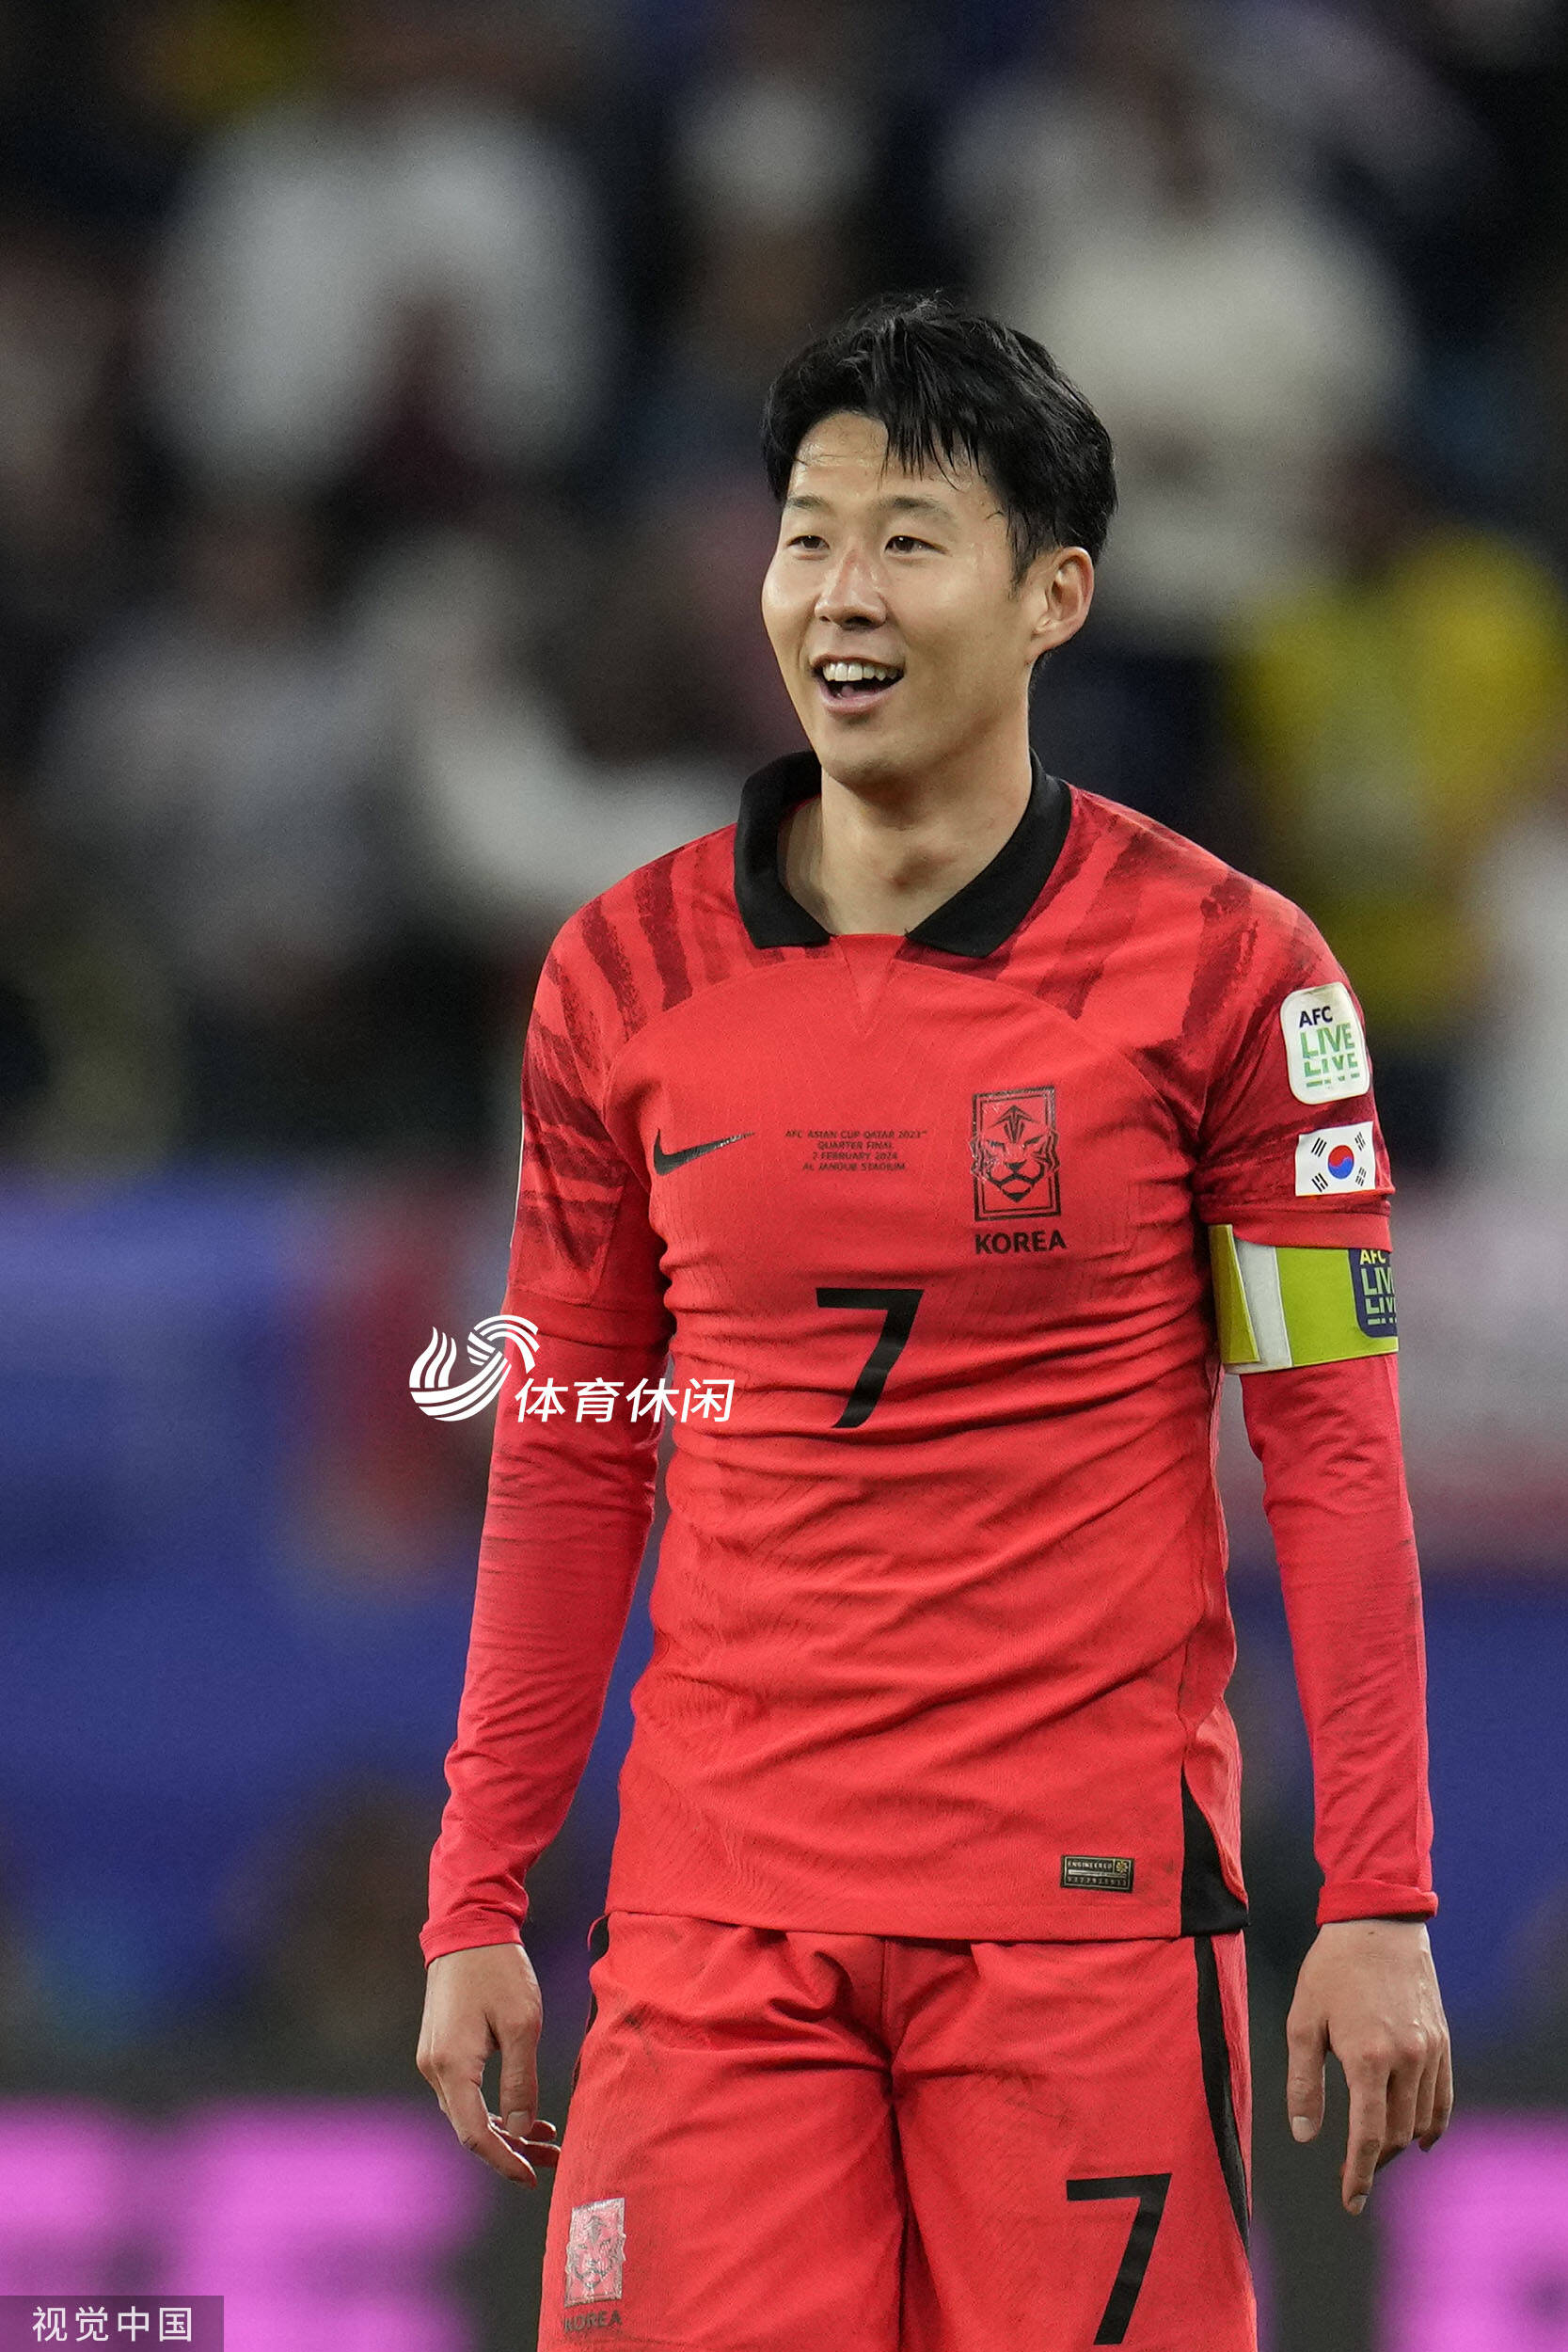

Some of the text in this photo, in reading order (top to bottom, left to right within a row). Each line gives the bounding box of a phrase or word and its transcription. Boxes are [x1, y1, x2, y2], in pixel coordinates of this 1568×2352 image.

[1298, 1006, 1334, 1028] AFC
[1300, 1022, 1355, 1059] LIVE
[785, 1130, 802, 1138] AFC
[807, 1130, 837, 1138] ASIAN
[840, 1130, 861, 1138] CUP
[863, 1130, 895, 1139] QATAR
[817, 1141, 863, 1150] QUARTER
[821, 1152, 871, 1160] FEBRUARY
[974, 1229, 1068, 1255] KOREA
[1360, 1249, 1386, 1265] AFC
[1361, 1266, 1394, 1295] LIV
[1365, 1296, 1397, 1314] LIV
[816, 1287, 926, 1428] 7
[1066, 2172, 1173, 2345] 7
